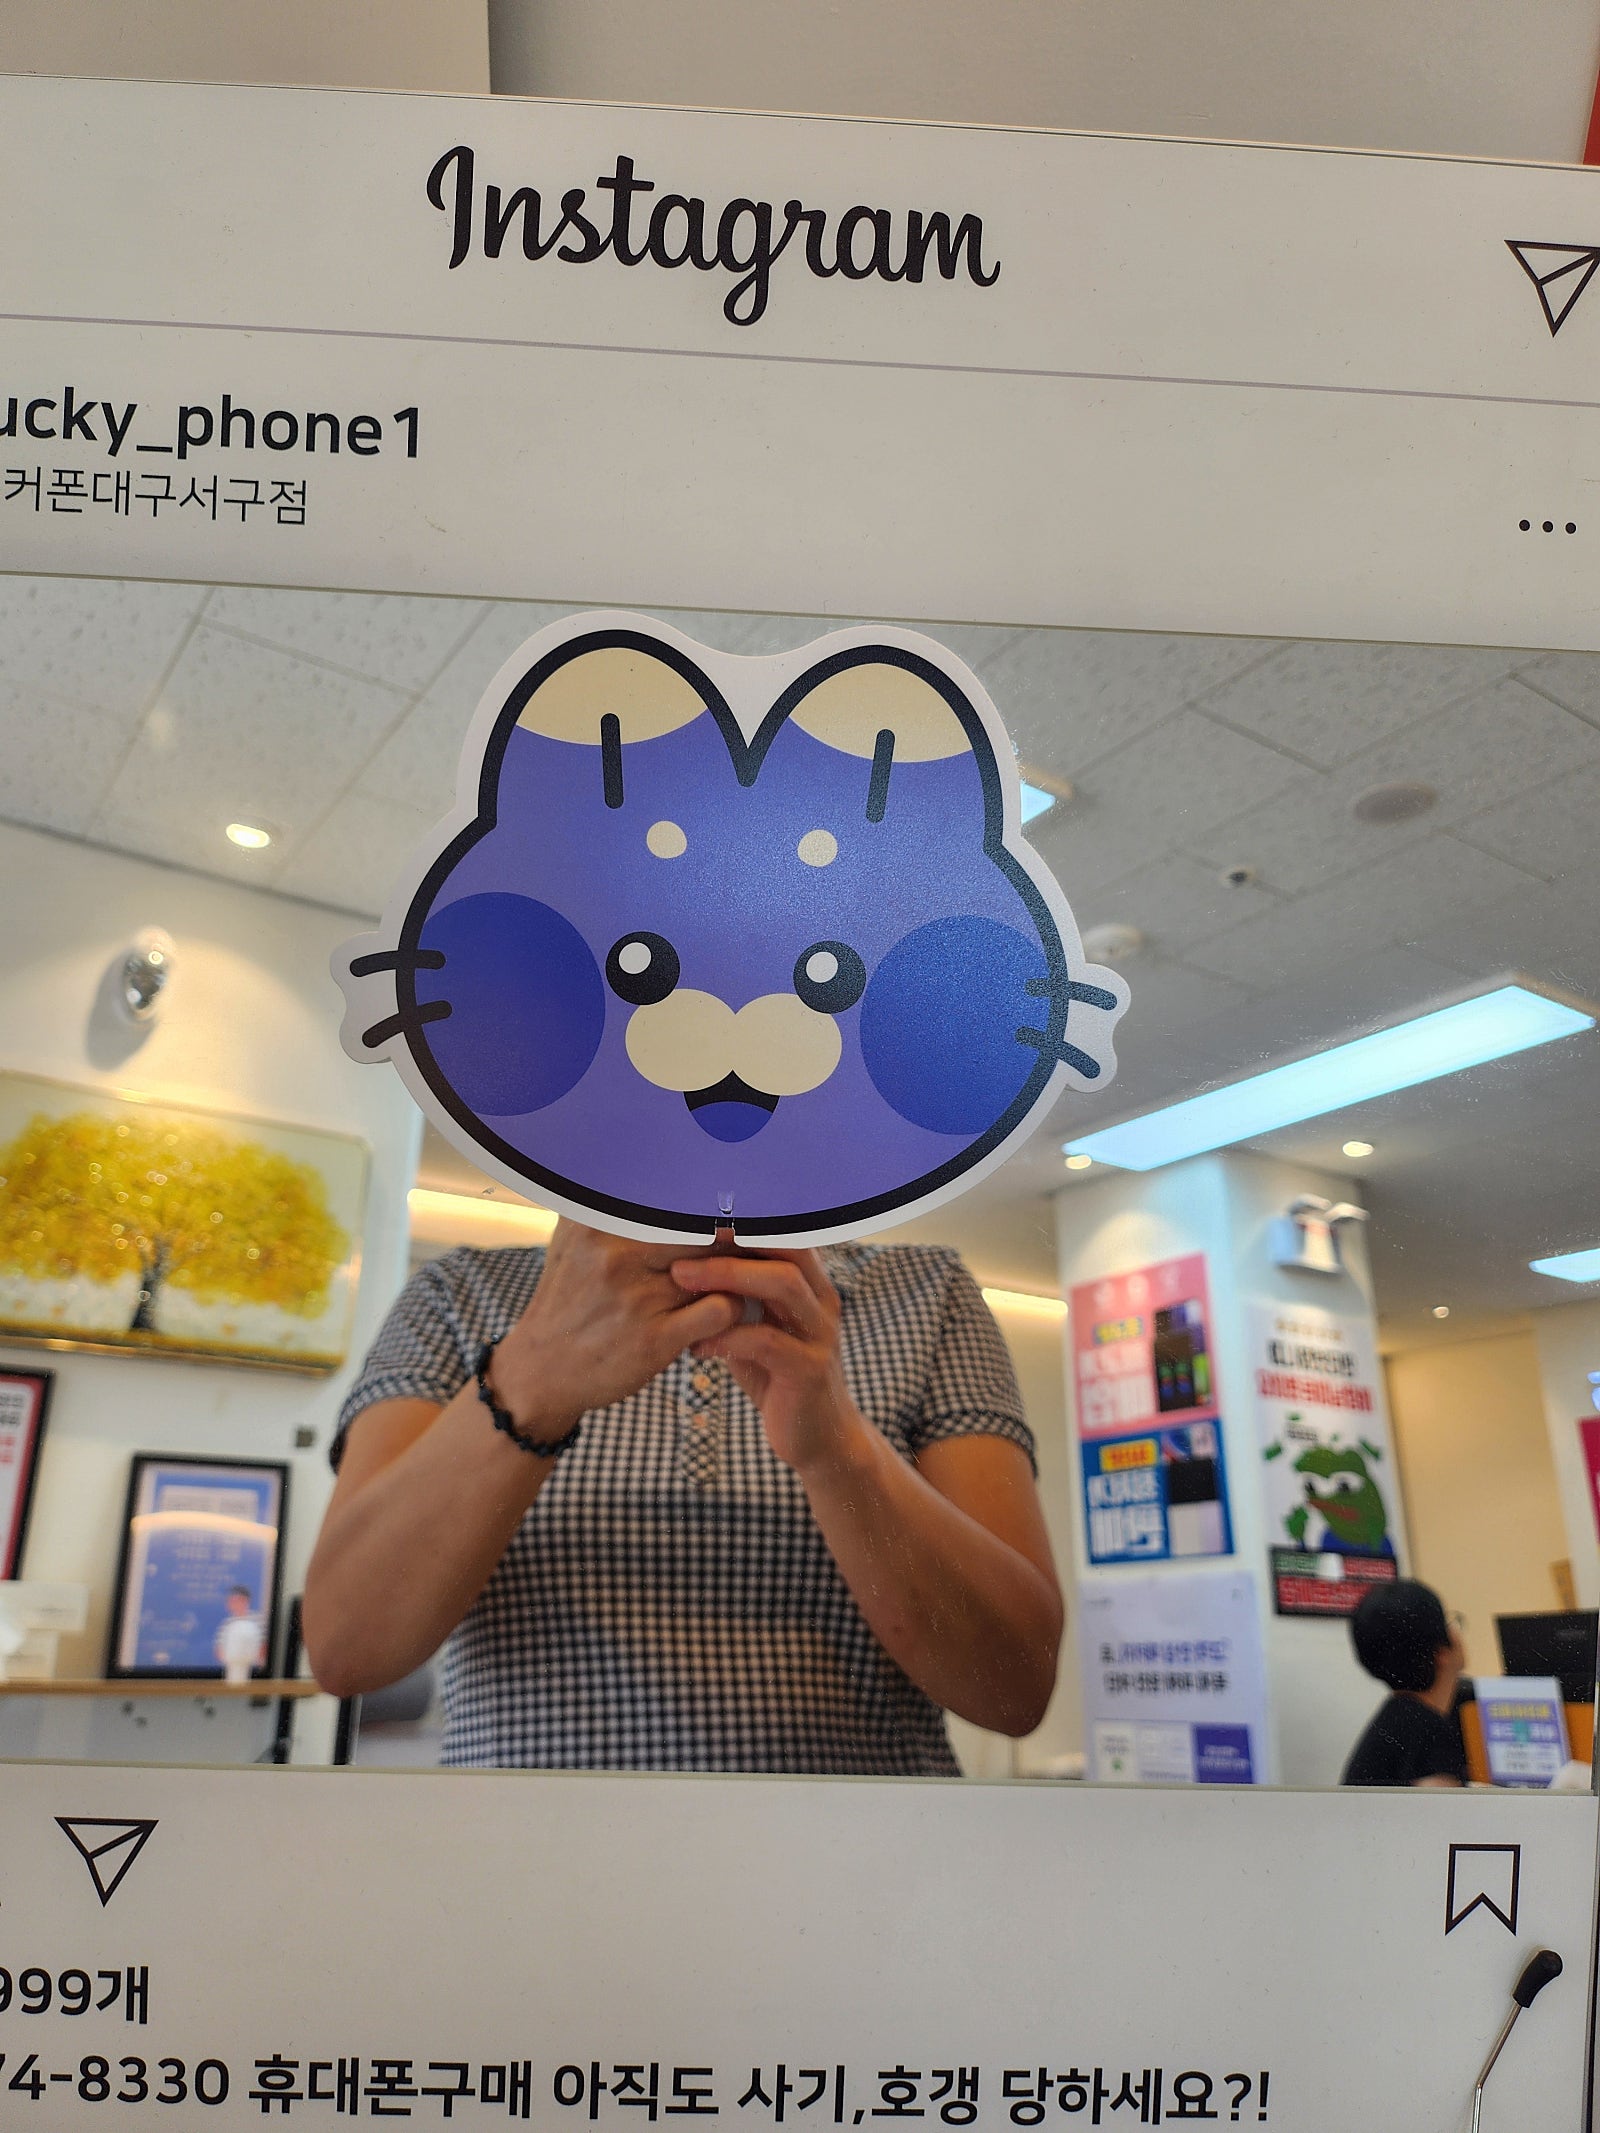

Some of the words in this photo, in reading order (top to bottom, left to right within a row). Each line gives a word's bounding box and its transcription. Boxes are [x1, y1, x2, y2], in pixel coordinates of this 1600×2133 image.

[426, 145, 1001, 326] Instagram
[4, 466, 307, 526] 커폰대구서구점
[0, 2053, 230, 2106] 4-8330
[248, 2053, 532, 2119] 휴대폰구매
[553, 2061, 720, 2122] 아직도
[736, 2063, 980, 2126] 사기,호갱
[1002, 2067, 1270, 2127] 당하세요?!
